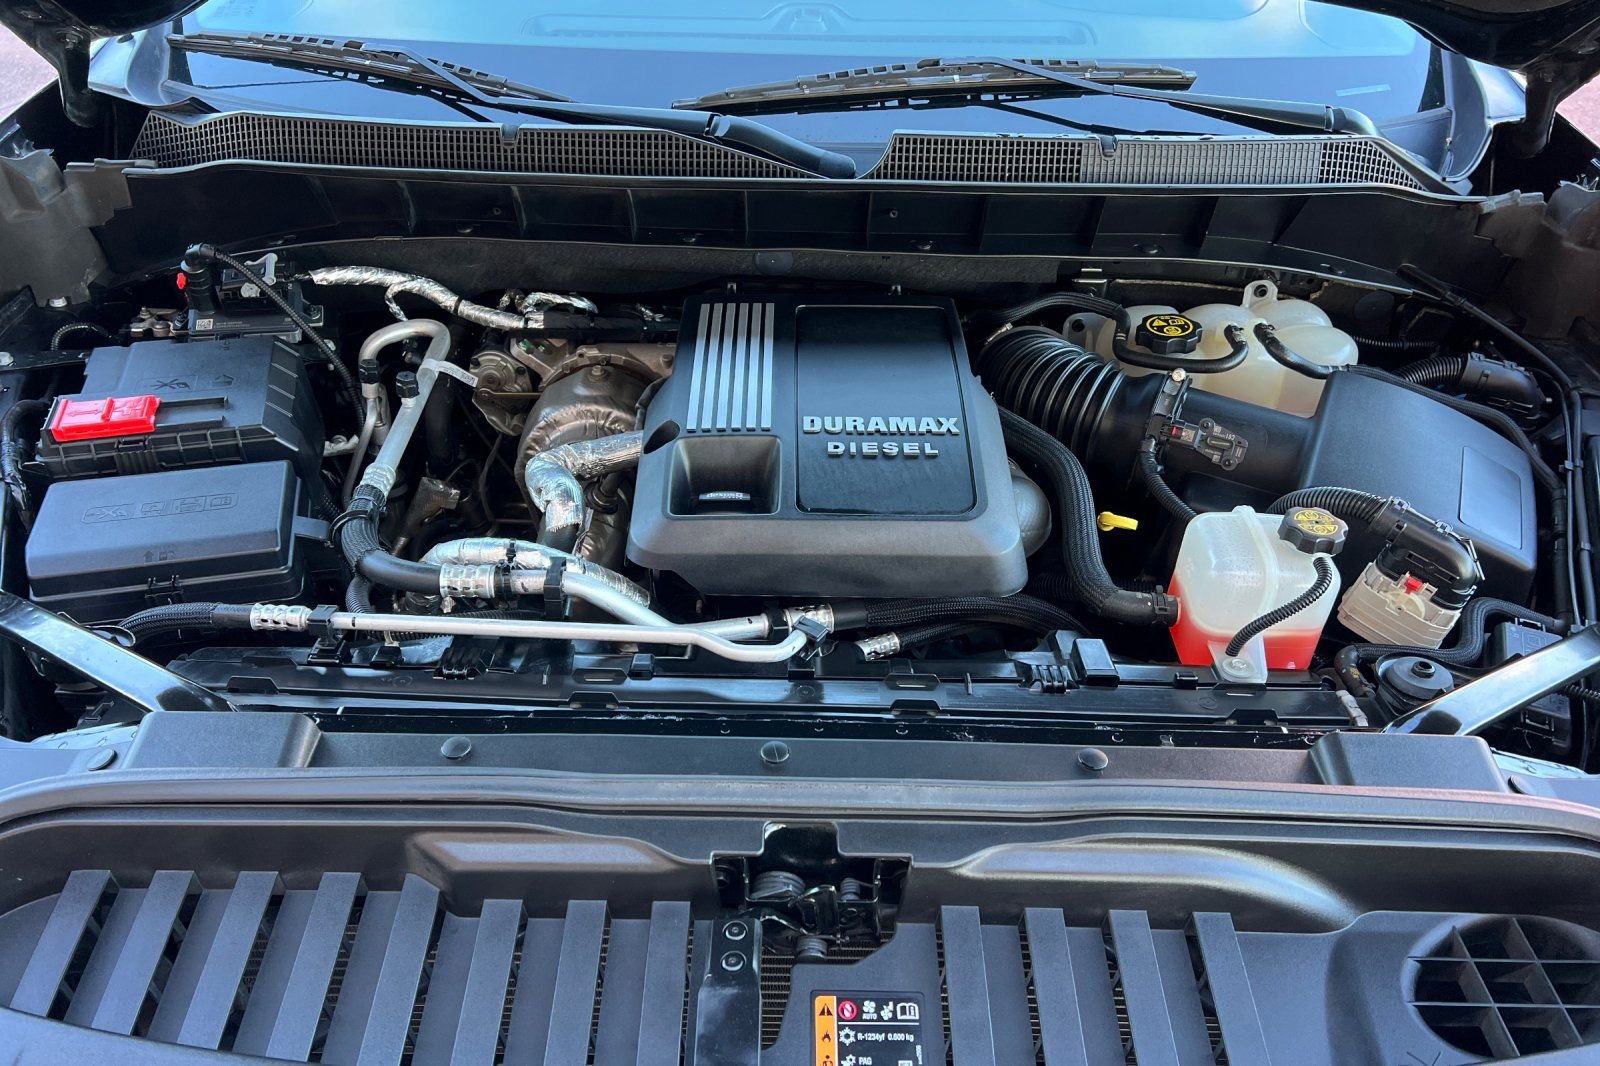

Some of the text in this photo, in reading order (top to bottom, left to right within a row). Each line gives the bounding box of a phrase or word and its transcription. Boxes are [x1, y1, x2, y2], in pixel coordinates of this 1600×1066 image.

[803, 416, 960, 435] DURAMAX
[827, 441, 939, 456] DIESEL
[858, 1057, 872, 1065] PAG
